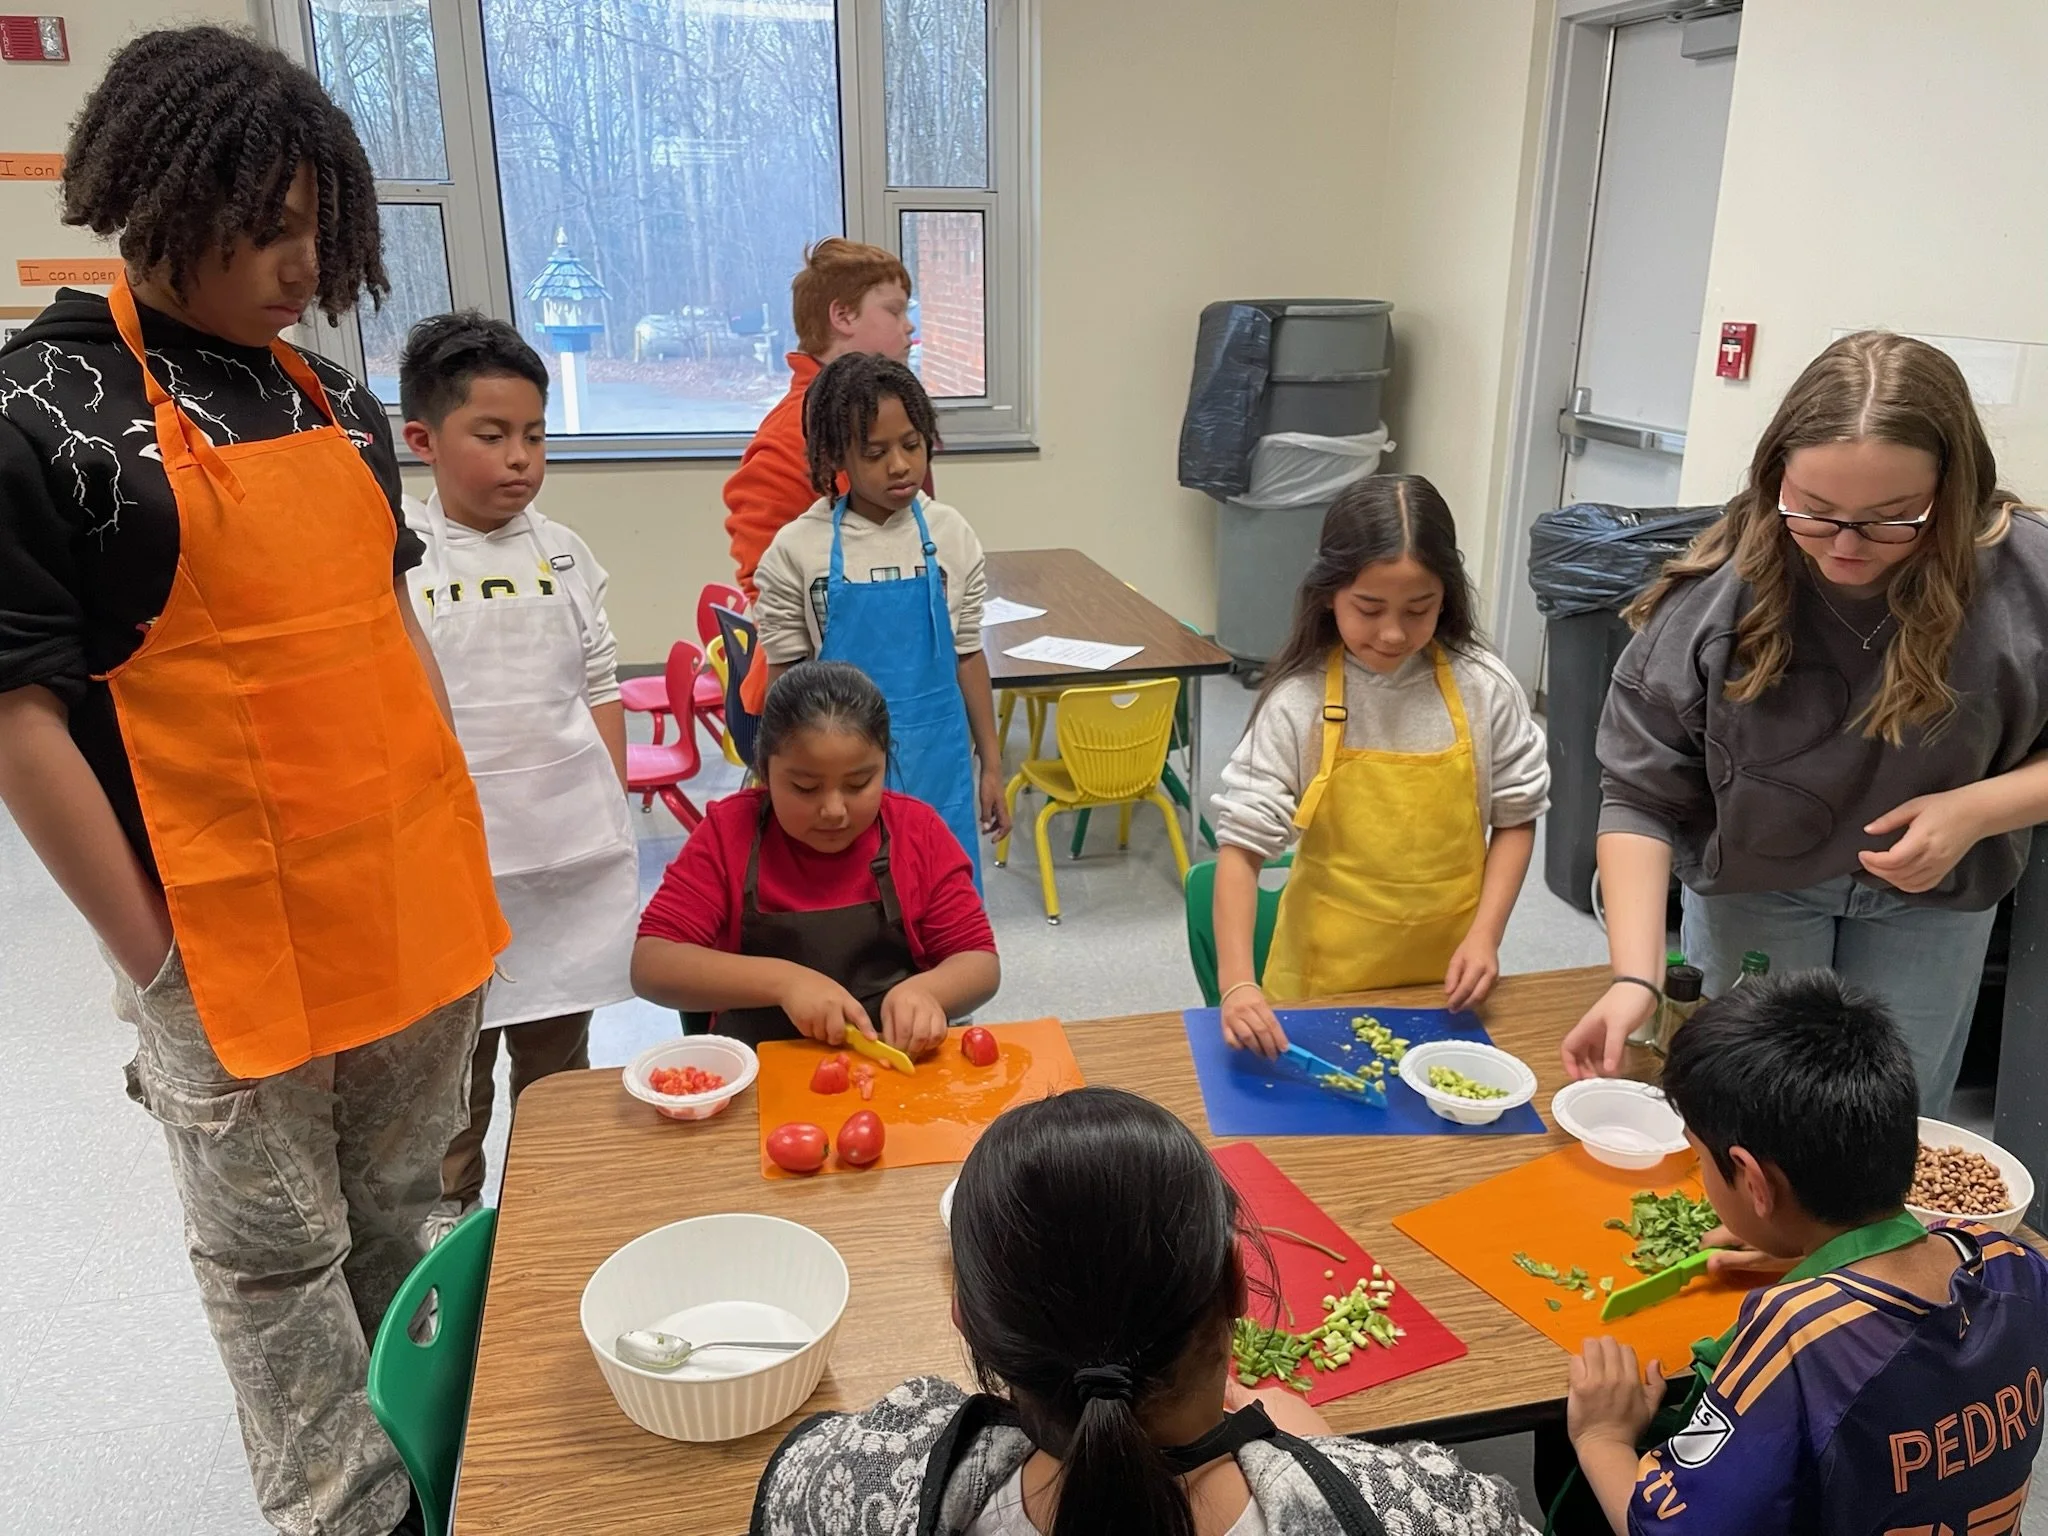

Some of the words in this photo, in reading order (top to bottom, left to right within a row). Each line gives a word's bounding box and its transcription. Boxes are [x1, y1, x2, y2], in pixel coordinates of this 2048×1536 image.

[0, 160, 16, 176] I
[23, 166, 55, 176] can
[20, 265, 41, 282] I
[48, 272, 77, 281] can
[82, 271, 116, 285] open
[1888, 1366, 2043, 1494] PEDRO
[1643, 1470, 1687, 1520] tv
